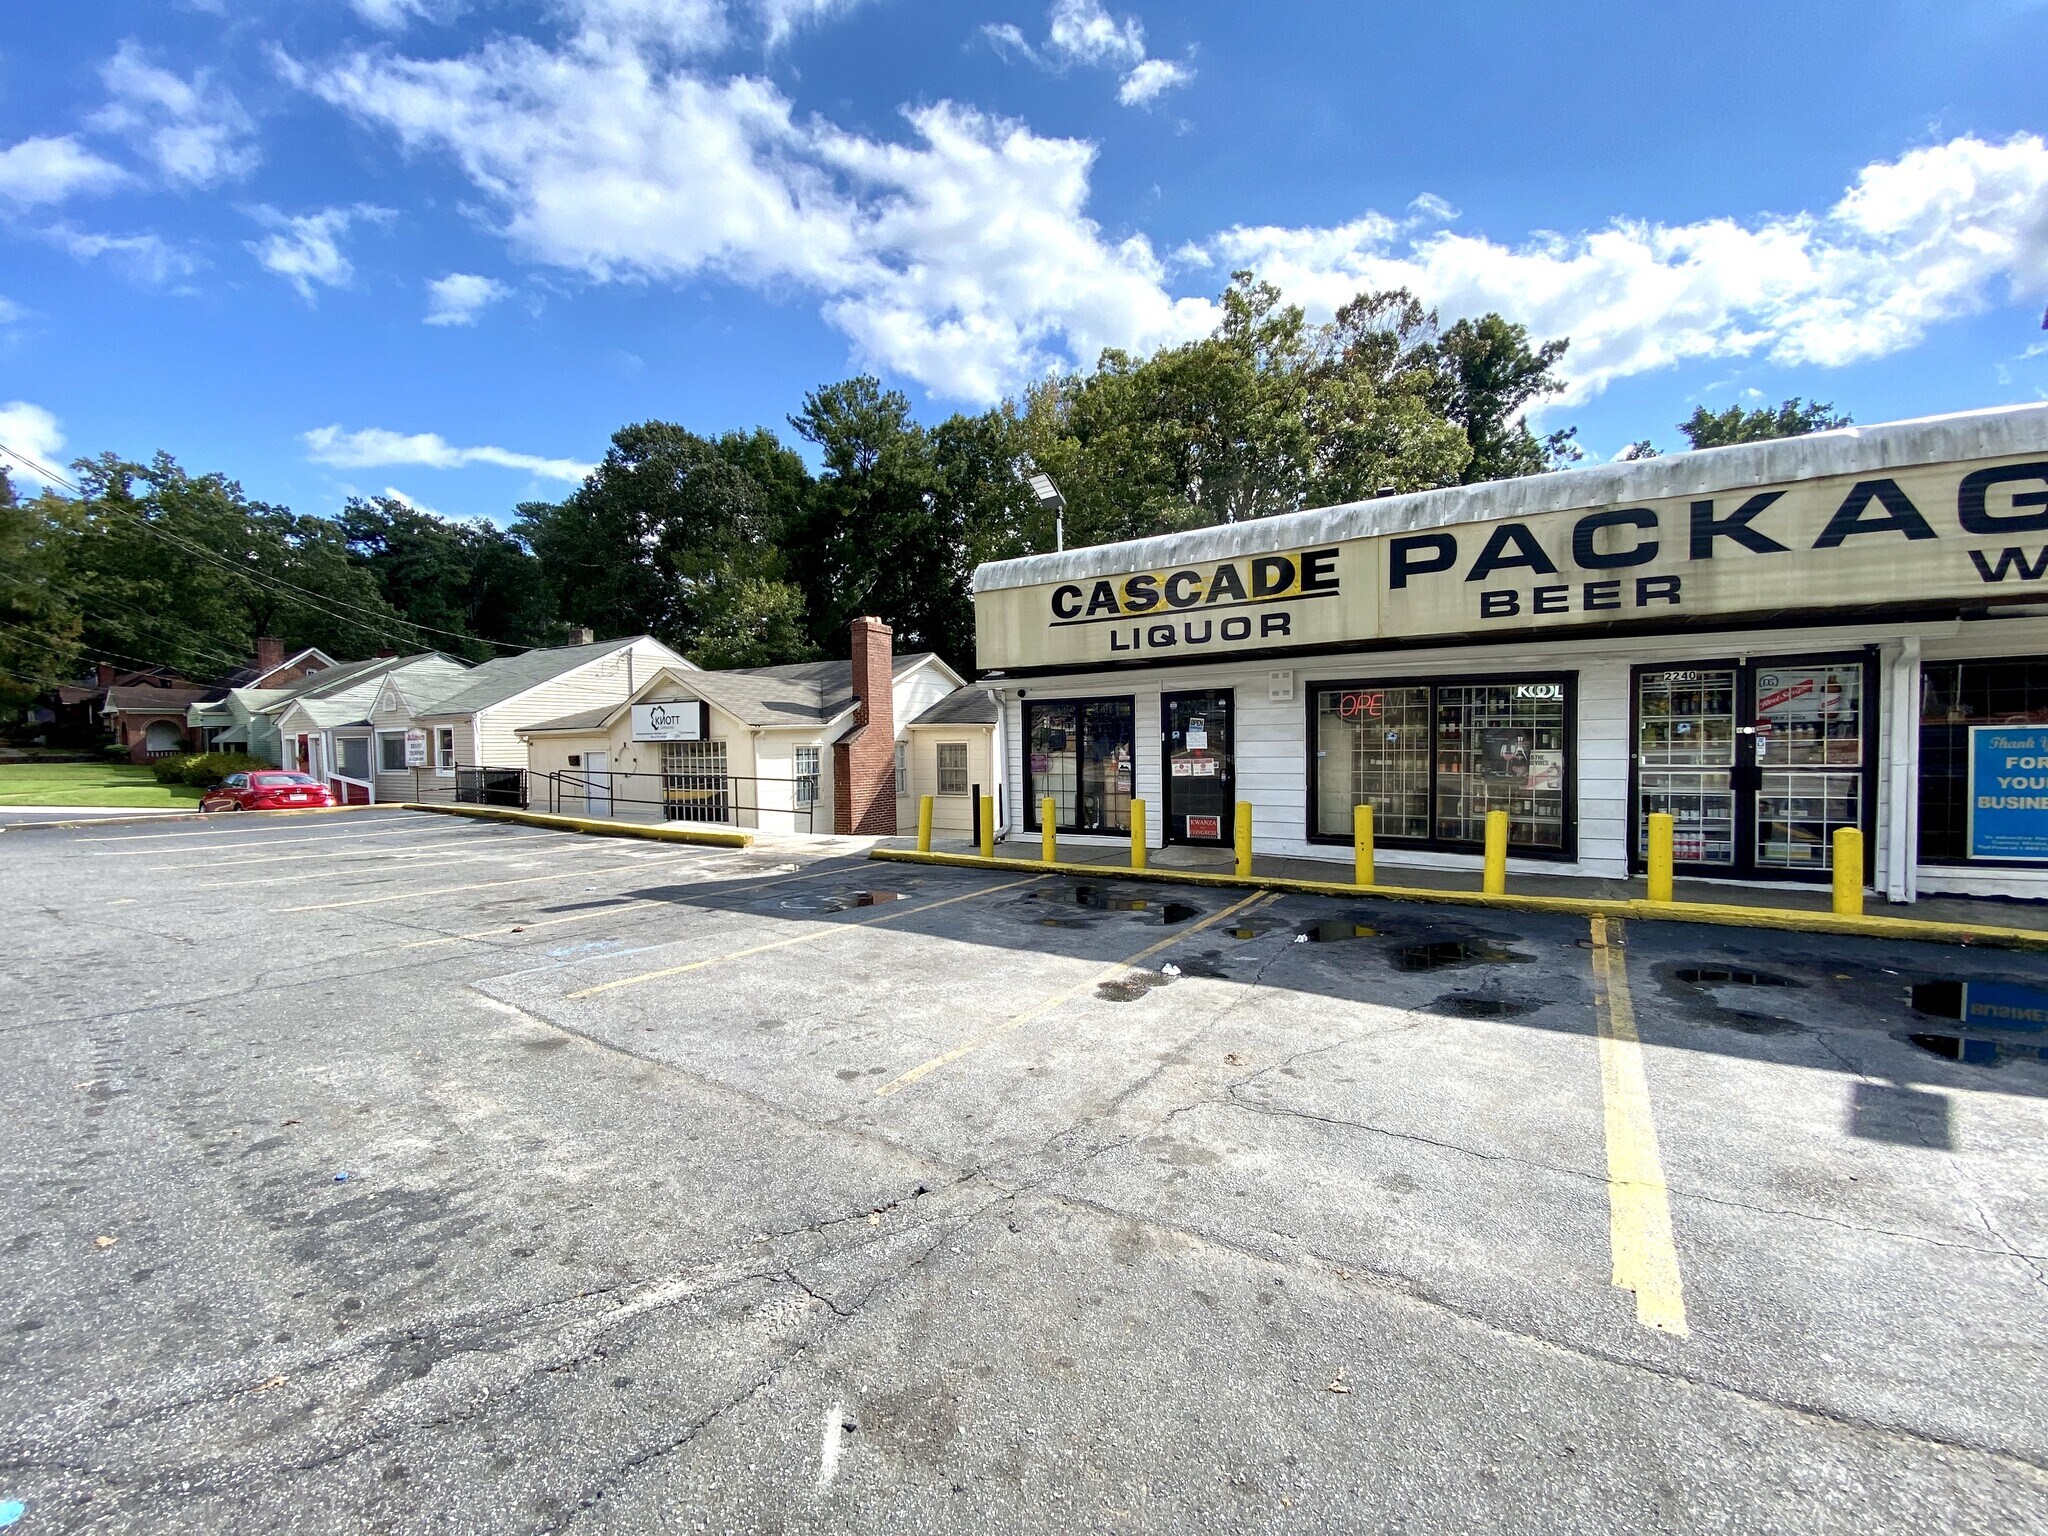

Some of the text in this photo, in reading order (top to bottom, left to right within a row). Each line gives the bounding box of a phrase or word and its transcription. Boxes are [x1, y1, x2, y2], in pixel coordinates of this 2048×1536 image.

[1389, 462, 2048, 589] PACKAG
[1051, 548, 1340, 619] CASCADE
[1480, 575, 1682, 619] BEER
[1111, 612, 1291, 651] LIQUOR
[1664, 671, 1696, 680] 2240
[1516, 685, 1563, 701] KOOL
[1988, 736, 2035, 750] Thank
[2005, 757, 2048, 769] FOR
[1996, 776, 2048, 790] YOU
